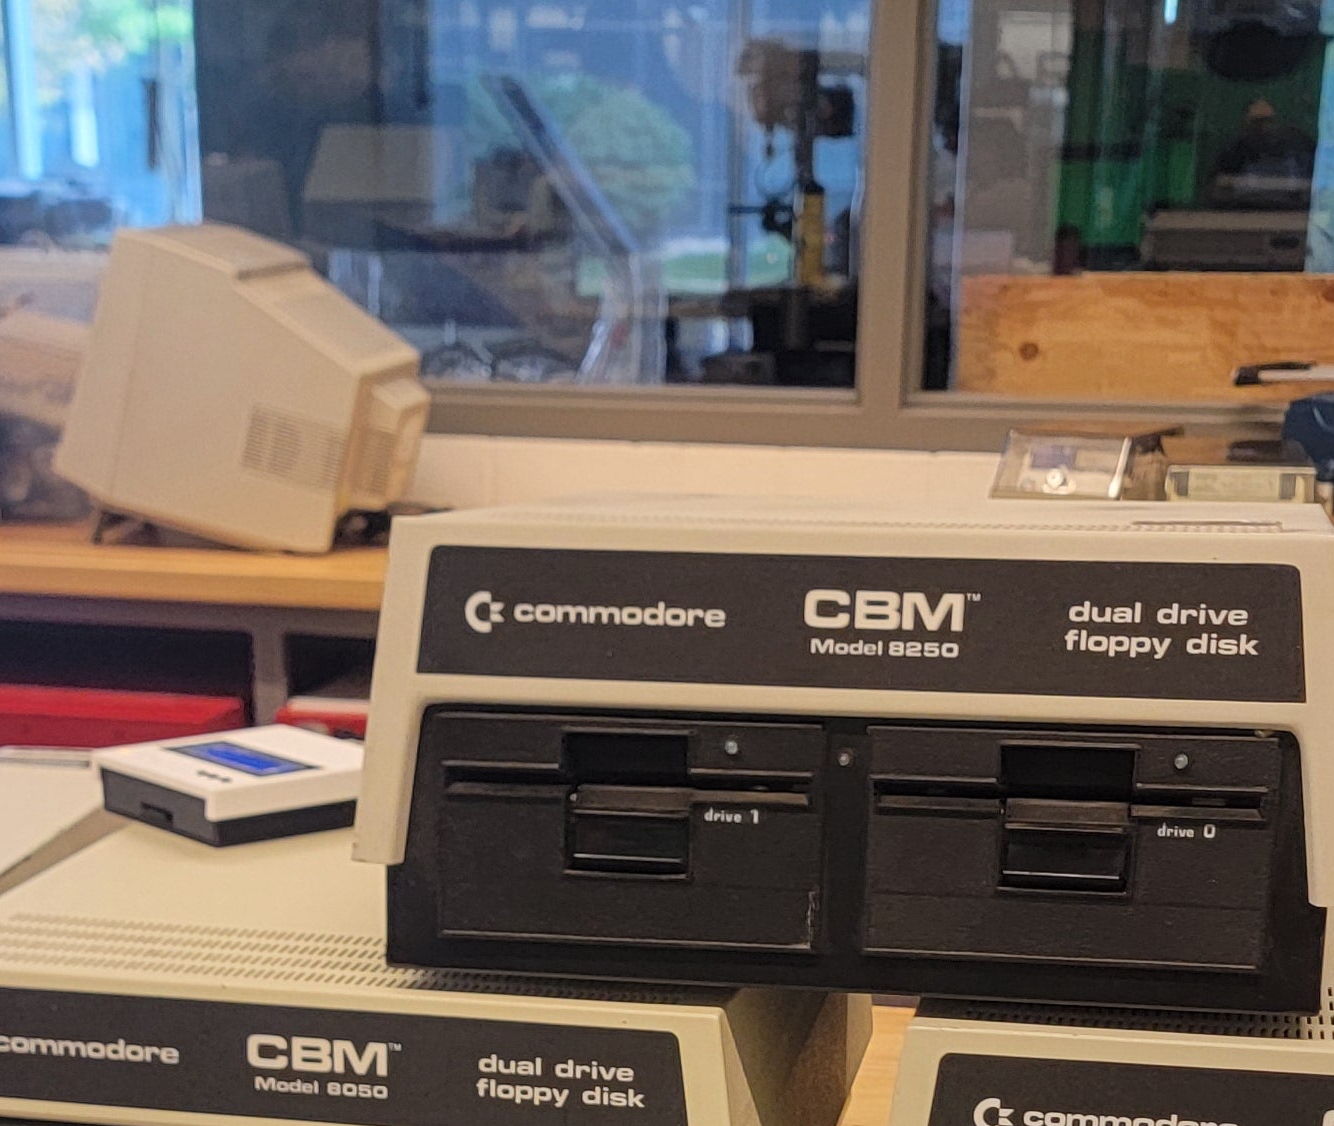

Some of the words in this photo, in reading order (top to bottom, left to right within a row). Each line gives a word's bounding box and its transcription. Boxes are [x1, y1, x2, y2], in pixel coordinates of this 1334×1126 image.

[513, 601, 727, 629] commodore
[1068, 601, 1143, 624] dual
[1156, 603, 1250, 626] drive
[810, 638, 884, 656] Model
[887, 641, 961, 659] 8250
[1064, 629, 1173, 660] floppy
[1186, 634, 1260, 656] disk
[703, 807, 743, 824] drive
[750, 808, 760, 825] 1
[1157, 822, 1195, 839] drive
[477, 1053, 544, 1077] dual
[554, 1058, 636, 1082] drive
[254, 1075, 320, 1095] Model
[326, 1081, 390, 1100] 8050
[476, 1077, 571, 1108] floppy
[581, 1085, 646, 1108] disk
